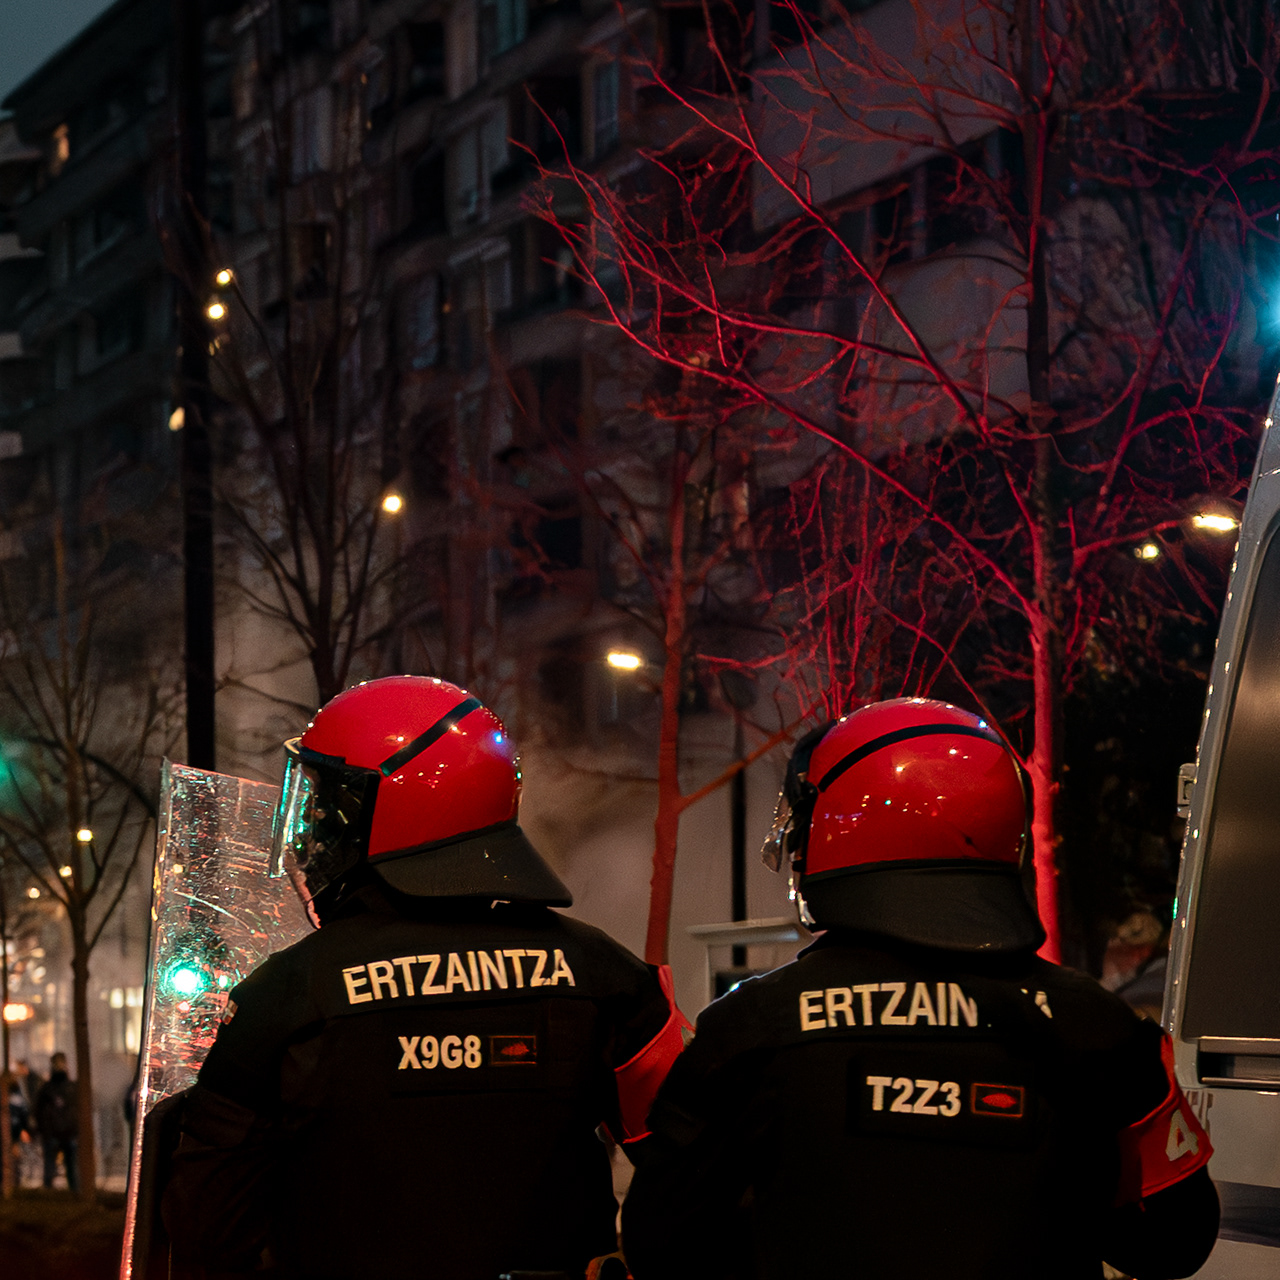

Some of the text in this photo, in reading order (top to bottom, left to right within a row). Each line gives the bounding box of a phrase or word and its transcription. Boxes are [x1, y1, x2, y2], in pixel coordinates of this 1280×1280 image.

[342, 948, 576, 1005] ERTZAINTZA
[397, 1035, 482, 1070] X9G8
[866, 1075, 962, 1117] T2Z3
[1165, 1108, 1200, 1162] 4
